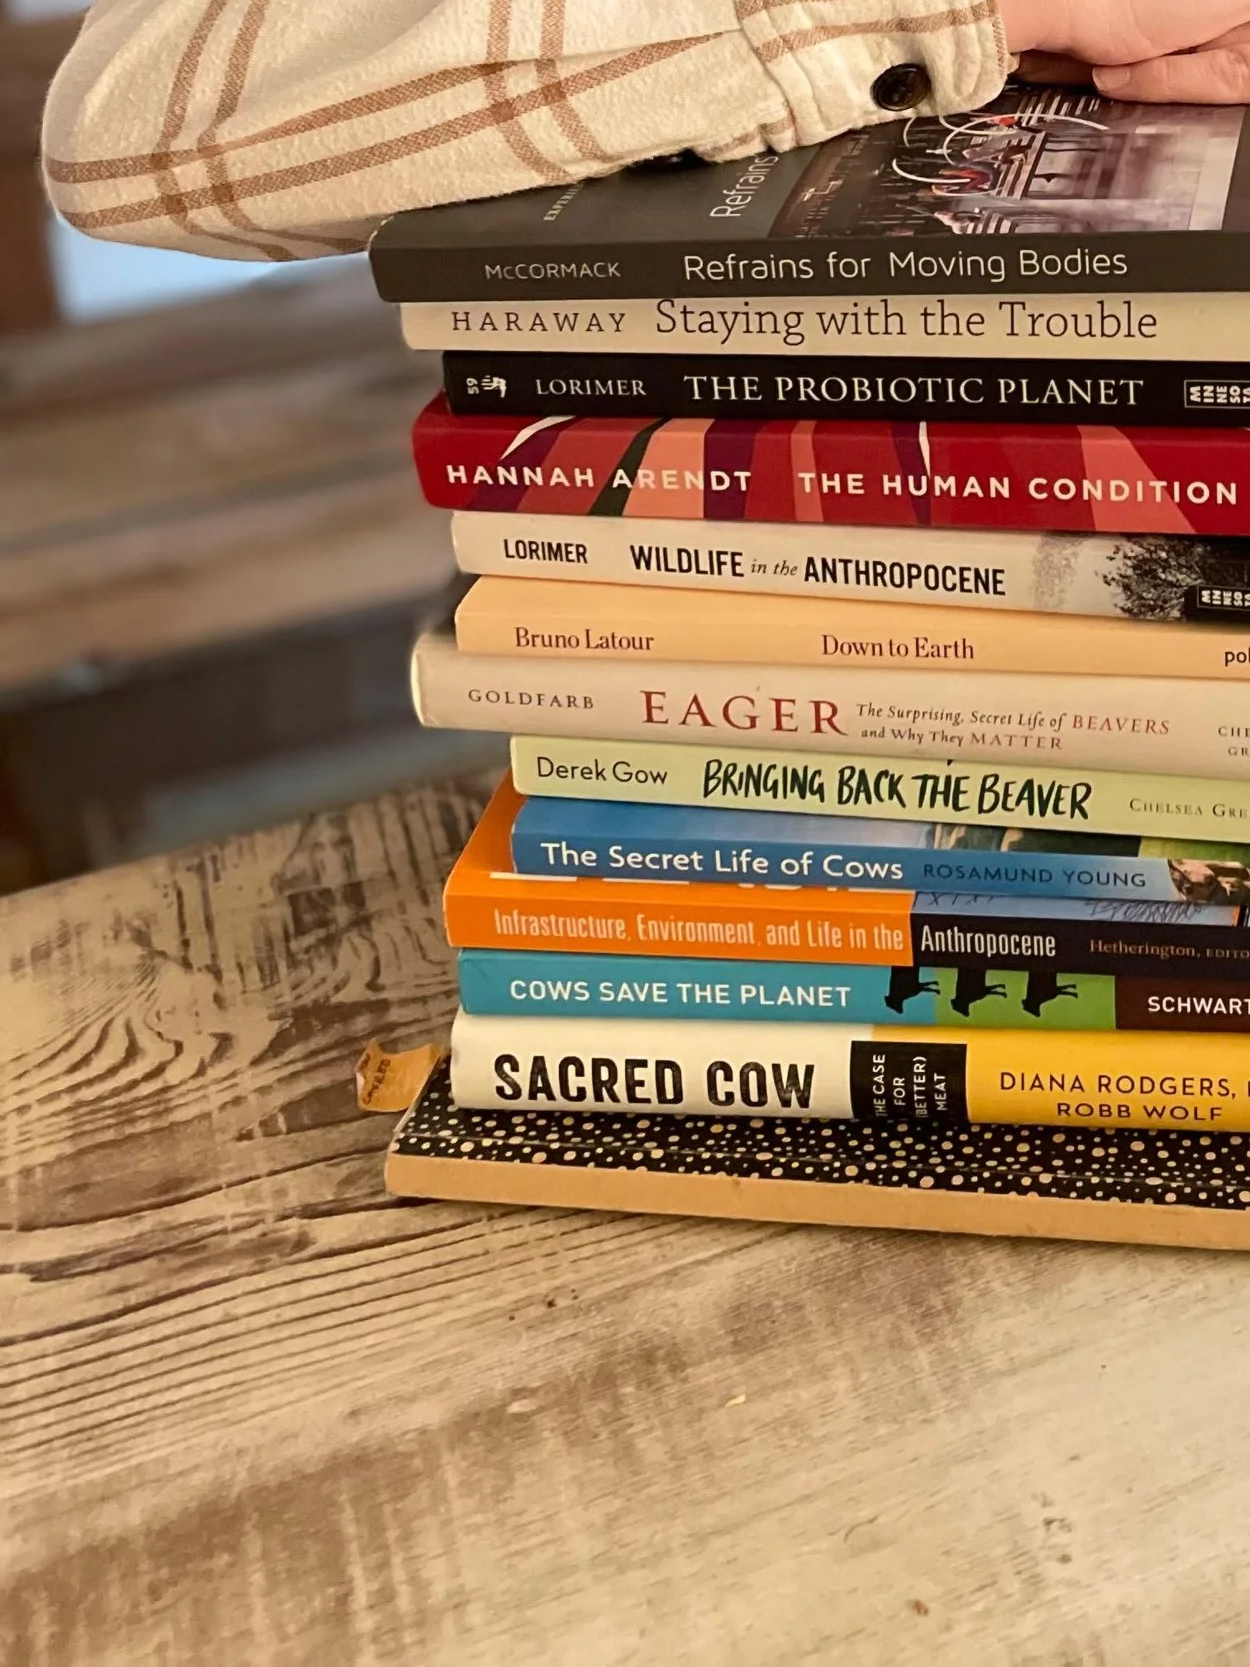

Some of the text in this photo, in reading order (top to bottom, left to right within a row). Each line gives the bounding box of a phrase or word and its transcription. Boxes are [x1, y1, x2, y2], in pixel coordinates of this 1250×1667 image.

[709, 155, 779, 218] Refrains
[684, 247, 1128, 283] Refrains for Moving Bodies
[452, 311, 626, 333] HARAWAY
[656, 298, 1158, 346] Staying with the Trouble
[535, 378, 648, 396] LORIMER
[683, 375, 1144, 406] THE PROBIOTIC PLANET
[446, 464, 752, 493] HANNAH ARENDT
[797, 472, 1237, 506] THE HUMAN CONDITION
[503, 538, 589, 565] LORIMER
[630, 544, 1006, 596] WILDLIFE in the ANTHROPOCENE
[515, 626, 655, 651] Bruno Latour
[822, 633, 975, 660] Down to Earth
[468, 688, 594, 710] GOLDFARB
[640, 689, 849, 736] EAGER
[856, 701, 1171, 735] The Surprising, Secret Life of BEAVERS
[861, 725, 1063, 750] and Why They MATTER
[537, 756, 668, 785] Derek Gow
[702, 757, 1092, 820] BRINGING BACK THE BEAVER
[540, 841, 904, 881] The Secret Life of Cows
[923, 863, 1053, 884] ROSAMUND
[1062, 869, 1146, 888] YOUNG
[494, 907, 1057, 960] Infrastructure, Environment, and Life in the Anthropocene
[1089, 938, 1201, 960] Hetherington,
[510, 979, 852, 1008] COWS SAVE THE PLANET
[494, 1053, 816, 1110] SACRED COW
[872, 1054, 888, 1118] THE CASE
[893, 1077, 906, 1106] FOR
[912, 1056, 929, 1119] (BETTER)
[934, 1072, 948, 1111] MEAT
[1000, 1071, 1086, 1094] DIANA
[1098, 1074, 1237, 1100] RODGERS,
[1057, 1102, 1224, 1122] ROBB WOLF
